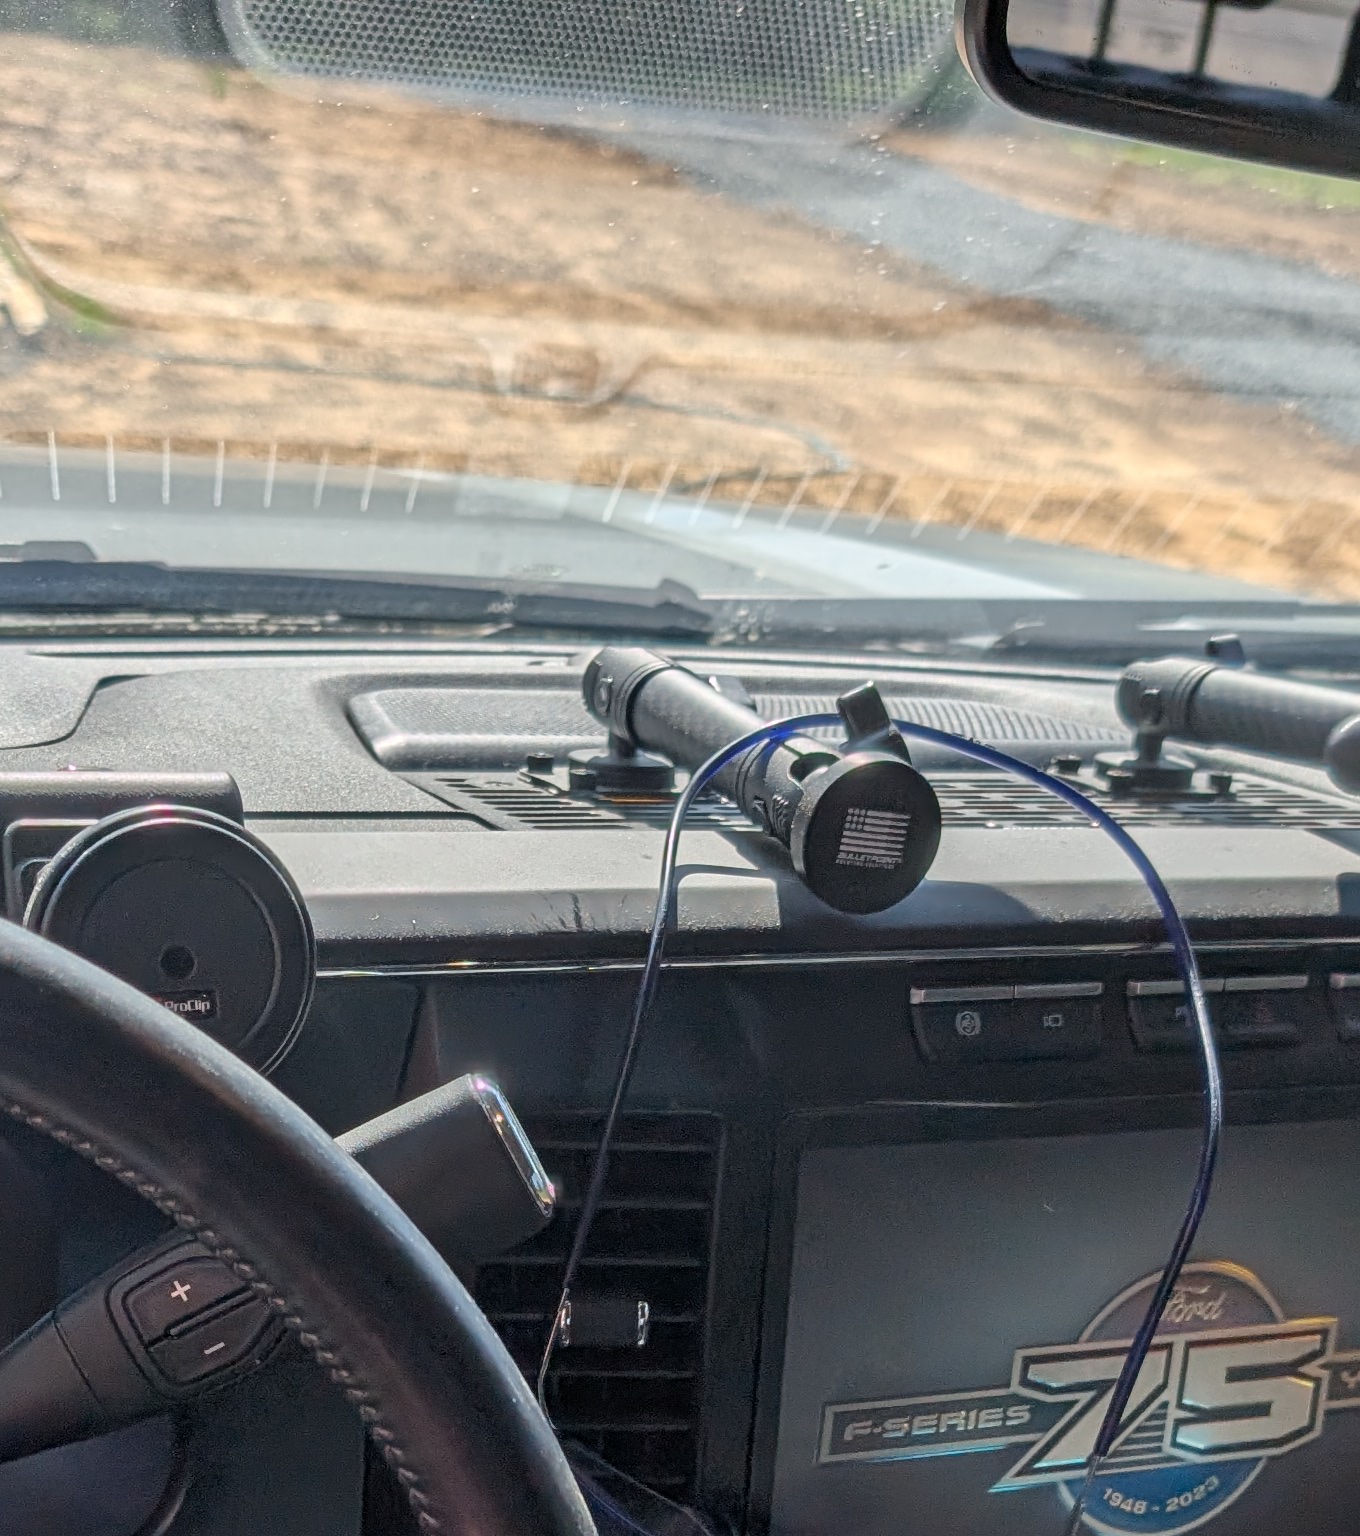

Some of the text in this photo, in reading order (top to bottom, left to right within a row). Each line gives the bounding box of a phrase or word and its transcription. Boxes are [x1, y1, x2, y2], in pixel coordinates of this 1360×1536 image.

[164, 999, 211, 1013] ProClip
[1002, 1325, 1333, 1480] 75
[842, 1404, 1034, 1442] F-SERIES
